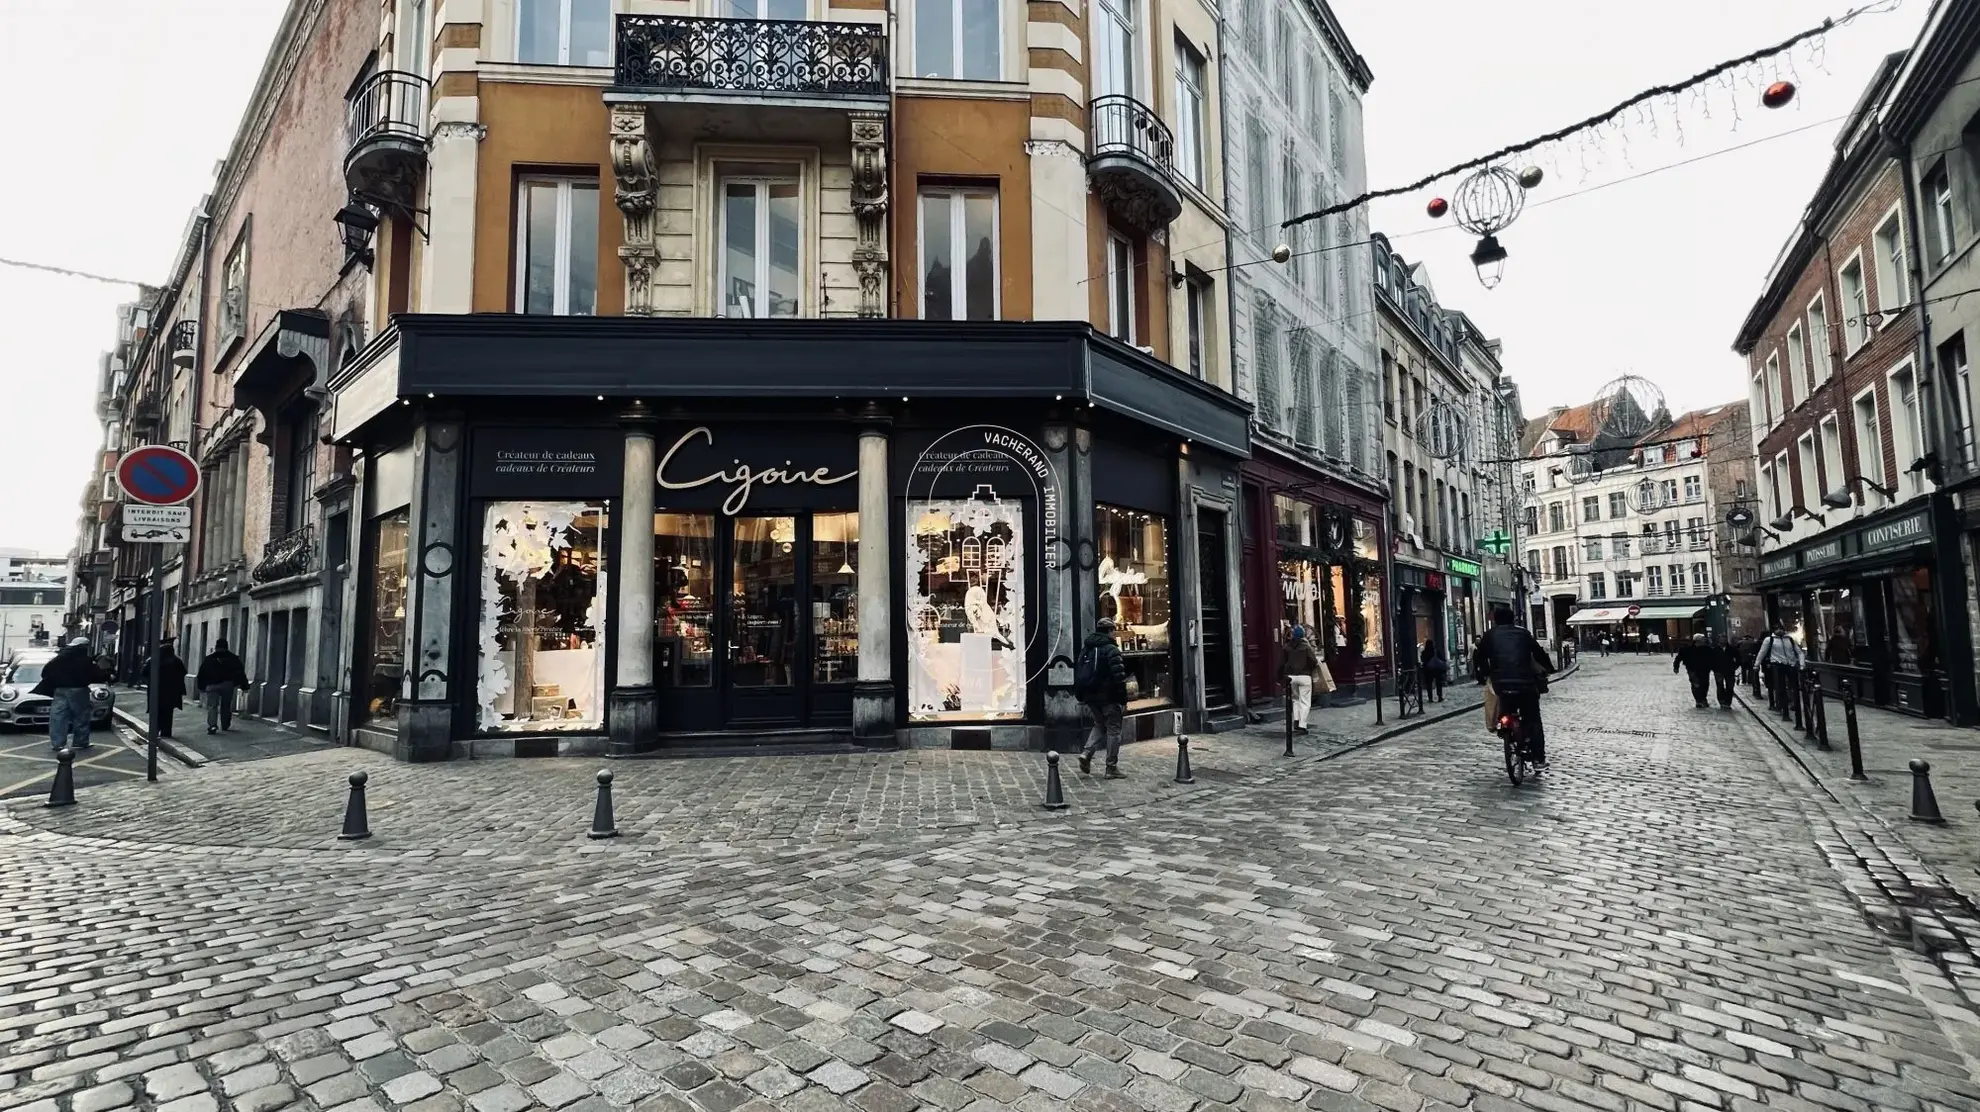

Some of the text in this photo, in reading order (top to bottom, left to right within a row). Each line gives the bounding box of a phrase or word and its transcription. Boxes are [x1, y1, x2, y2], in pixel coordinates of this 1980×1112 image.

[497, 450, 595, 460] Créateur de cadeaux
[495, 463, 596, 473] cadeaux de Créateurs
[656, 426, 859, 516] Cigoire
[918, 462, 1010, 473] cadeaux de Créateurs
[1867, 516, 1923, 546] CONFISERIE
